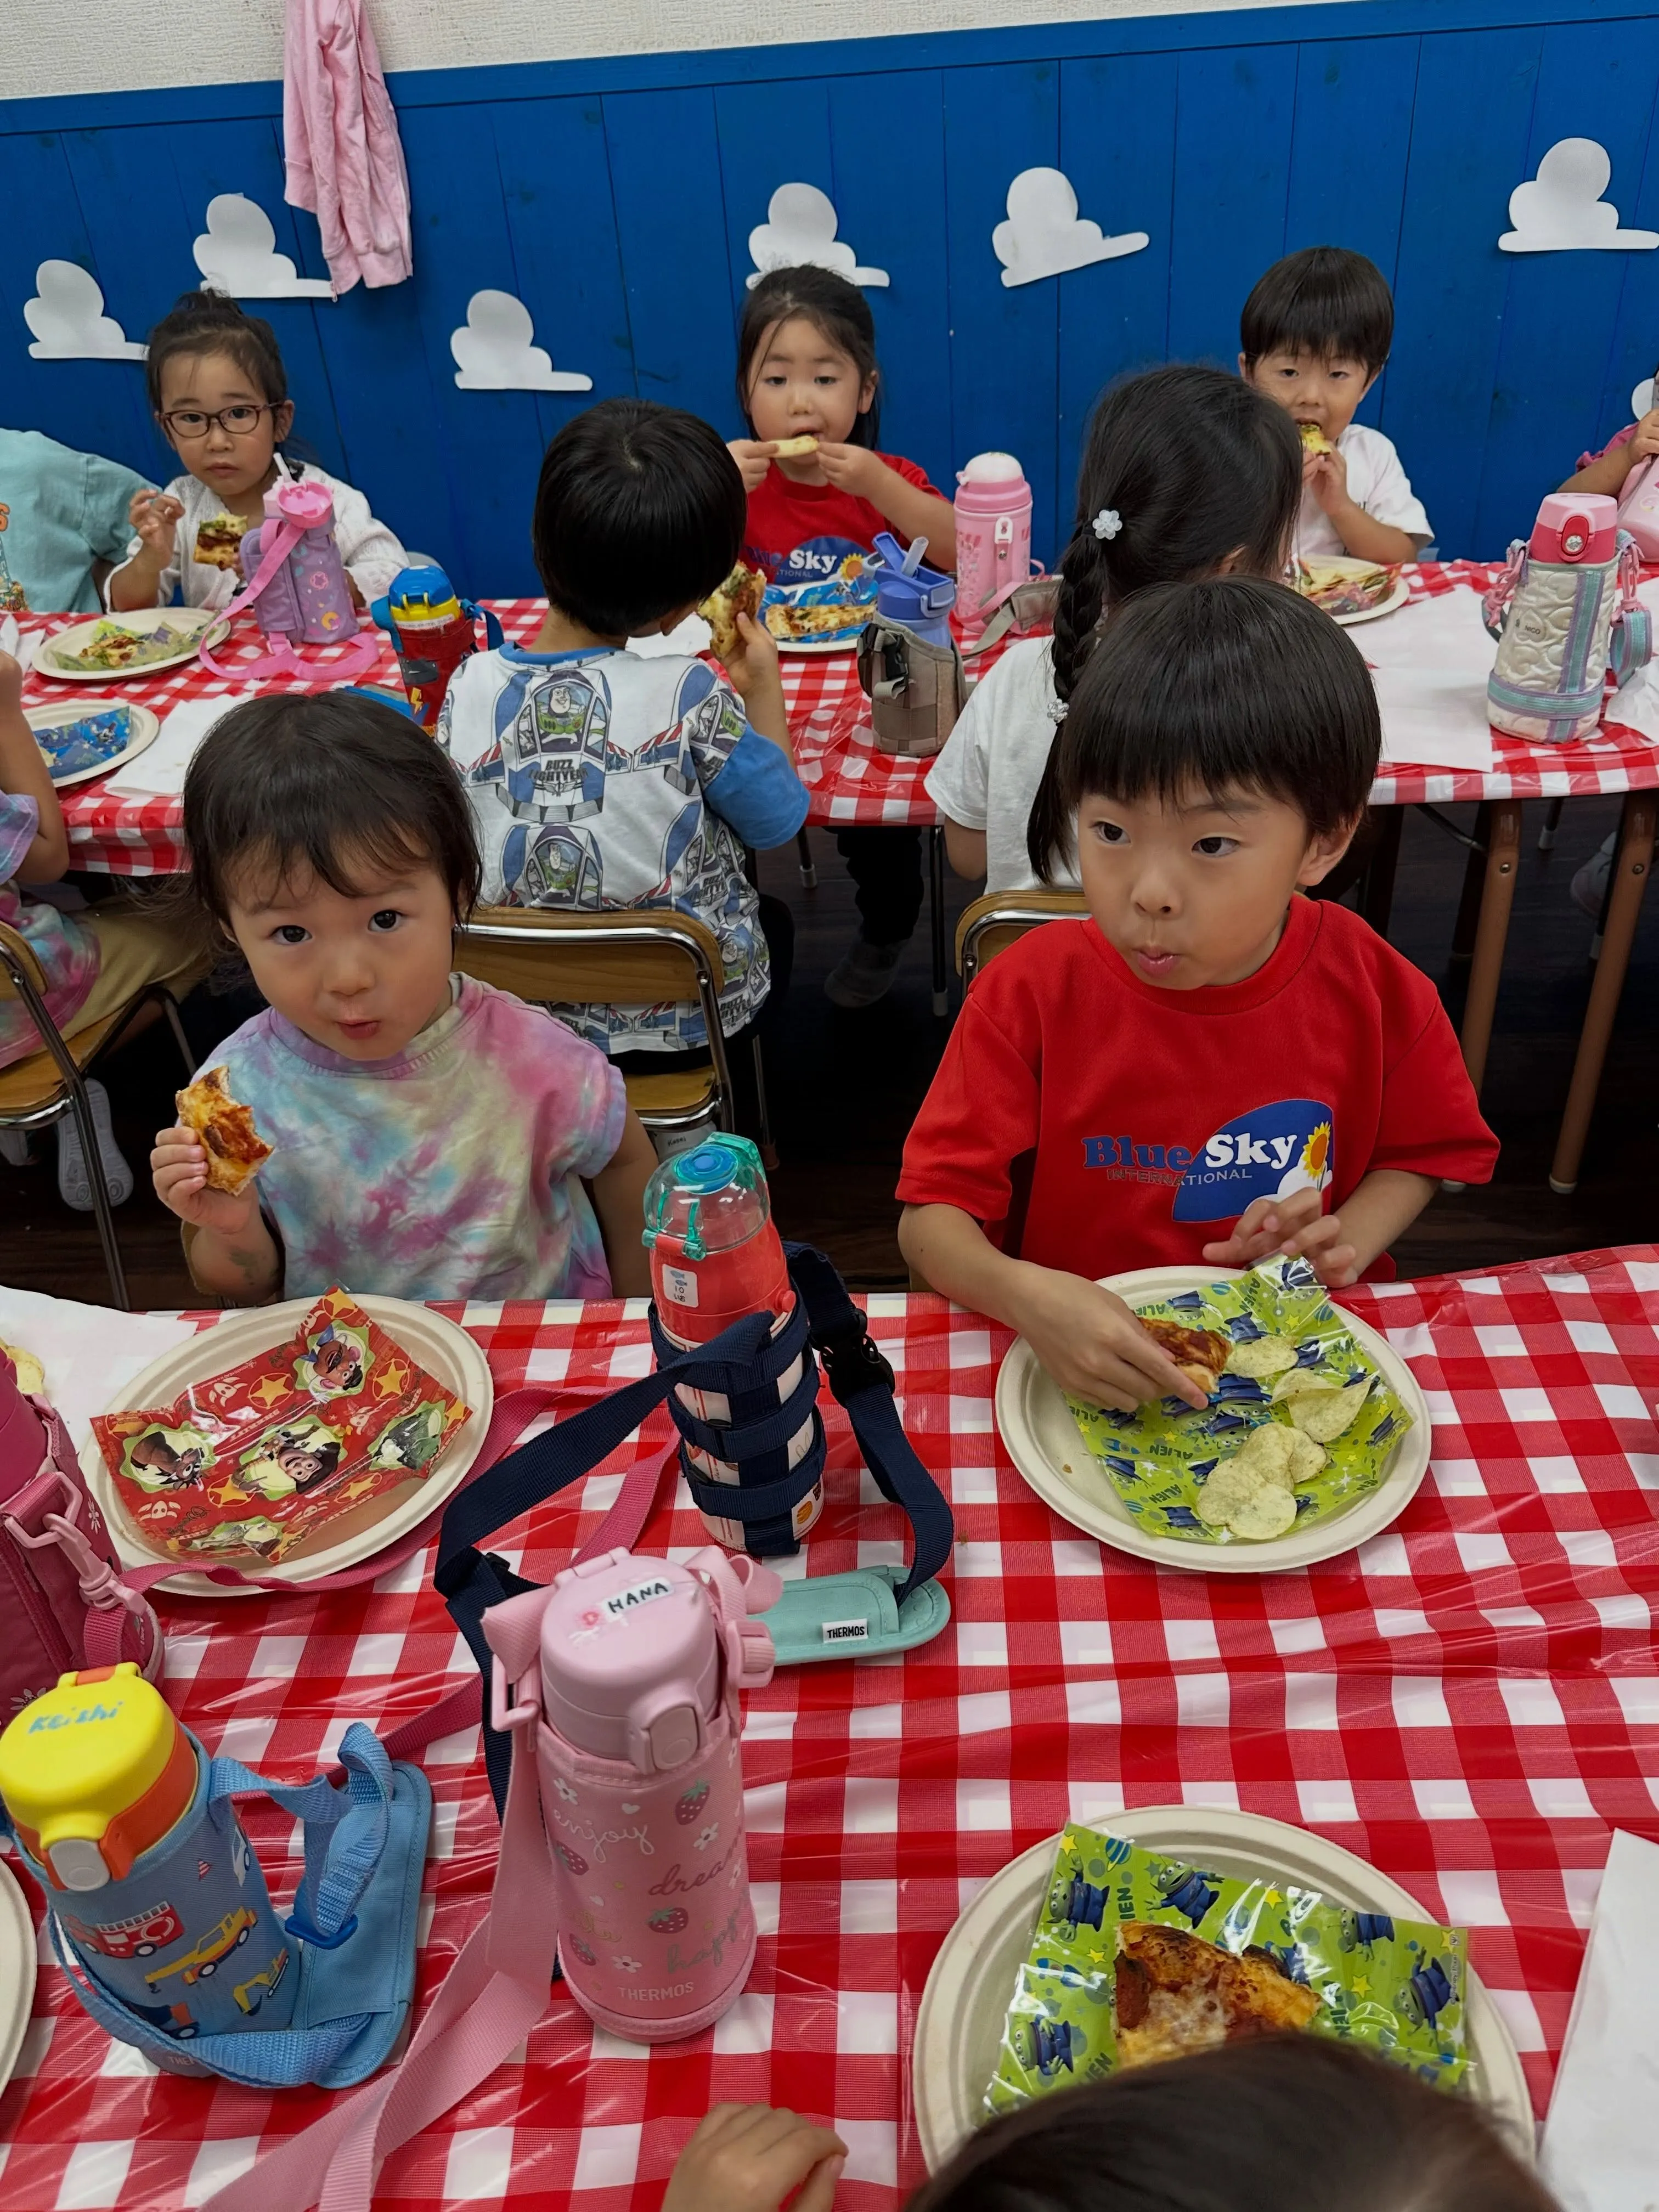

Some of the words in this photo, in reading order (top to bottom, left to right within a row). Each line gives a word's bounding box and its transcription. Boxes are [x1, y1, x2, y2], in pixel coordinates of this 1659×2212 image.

[789, 550, 837, 574] Sky
[1081, 1135, 1193, 1172] Blue
[1205, 1133, 1297, 1170] Sky
[1107, 1168, 1252, 1186] INTERNATIONAL
[1149, 1444, 1194, 1460] ALIEN
[1148, 1483, 1183, 1504] ALIEN
[607, 1582, 669, 1613] HANA
[827, 1626, 865, 1639] THERMOS
[554, 1809, 655, 1863] enjoy
[1116, 1887, 1136, 1920] IEN
[617, 1982, 694, 2001] THERMOS
